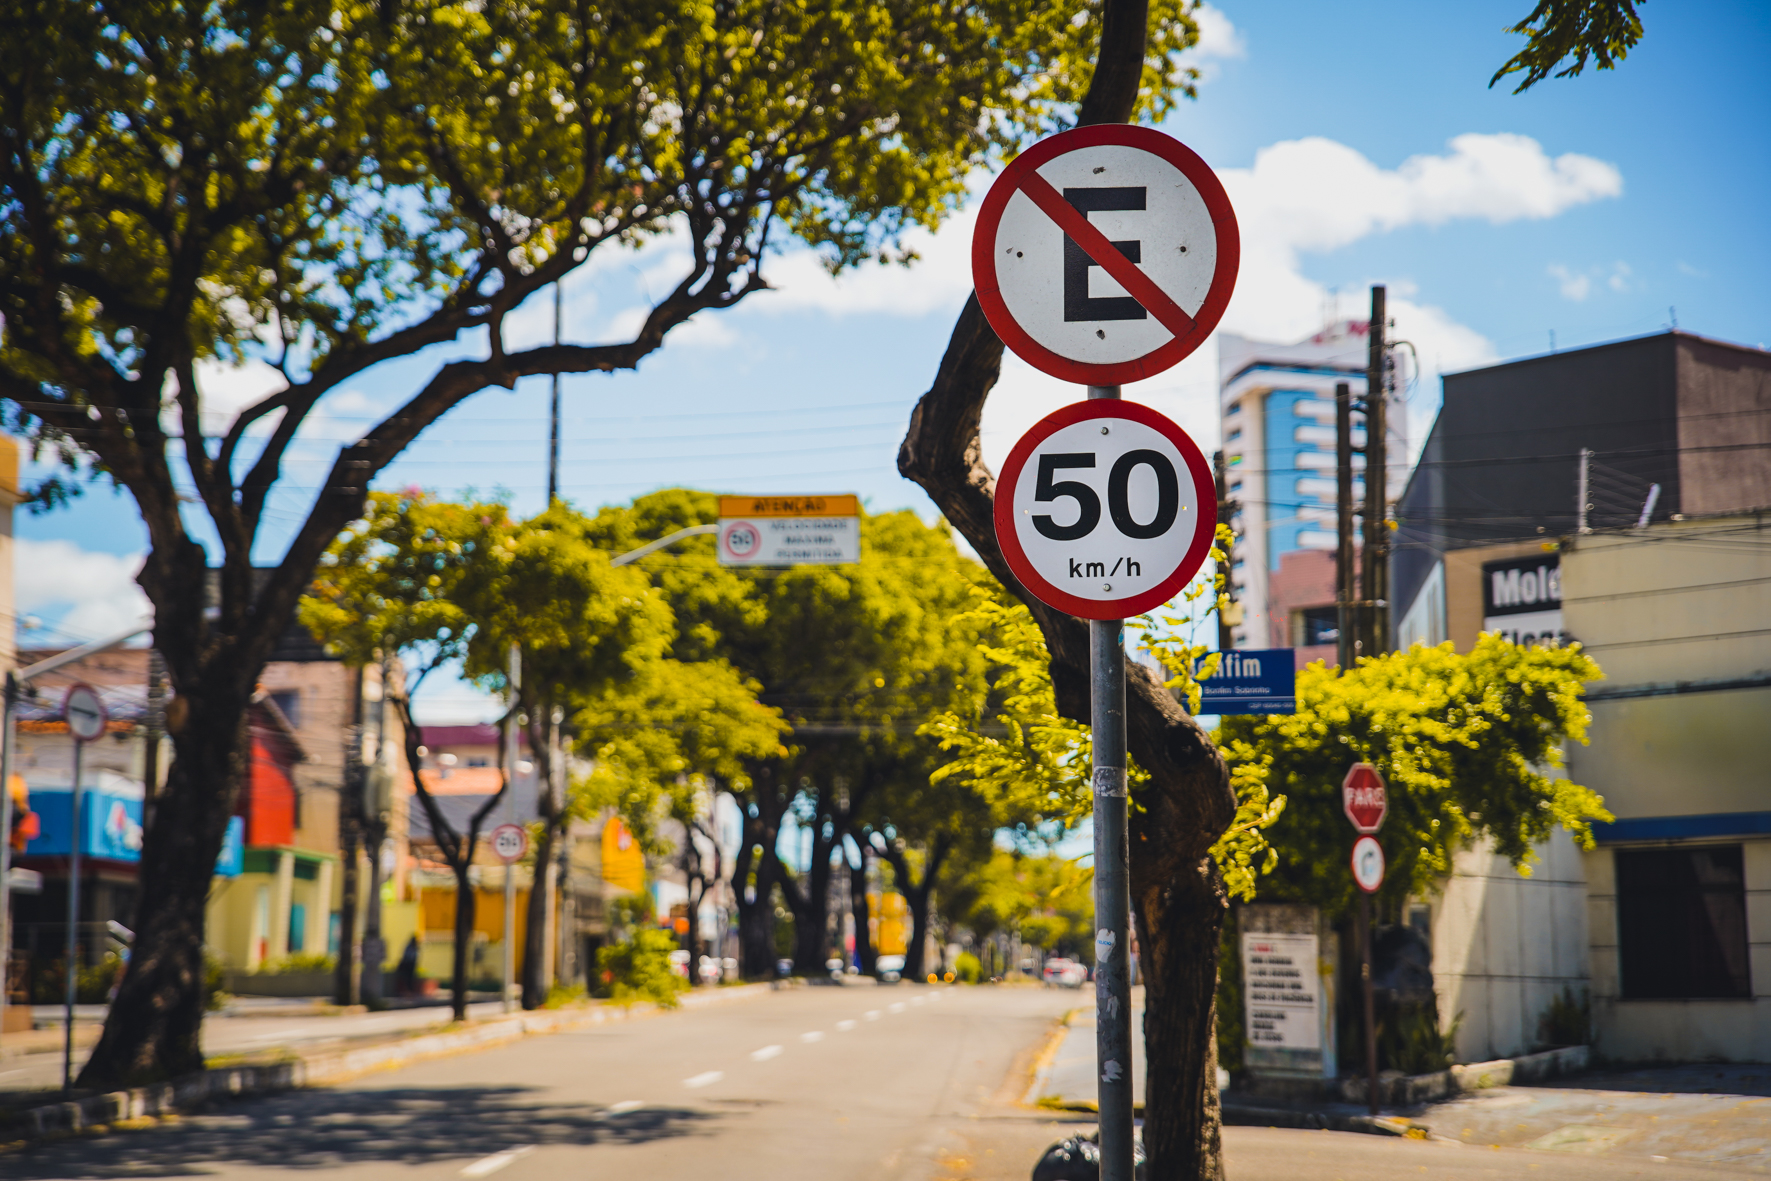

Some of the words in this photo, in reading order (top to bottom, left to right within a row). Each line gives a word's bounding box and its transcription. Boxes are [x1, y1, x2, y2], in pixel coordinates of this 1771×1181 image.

[1063, 186, 1147, 322] E
[1031, 449, 1179, 541] 50
[1069, 557, 1142, 578] km/h
[1344, 786, 1386, 808] PARE
